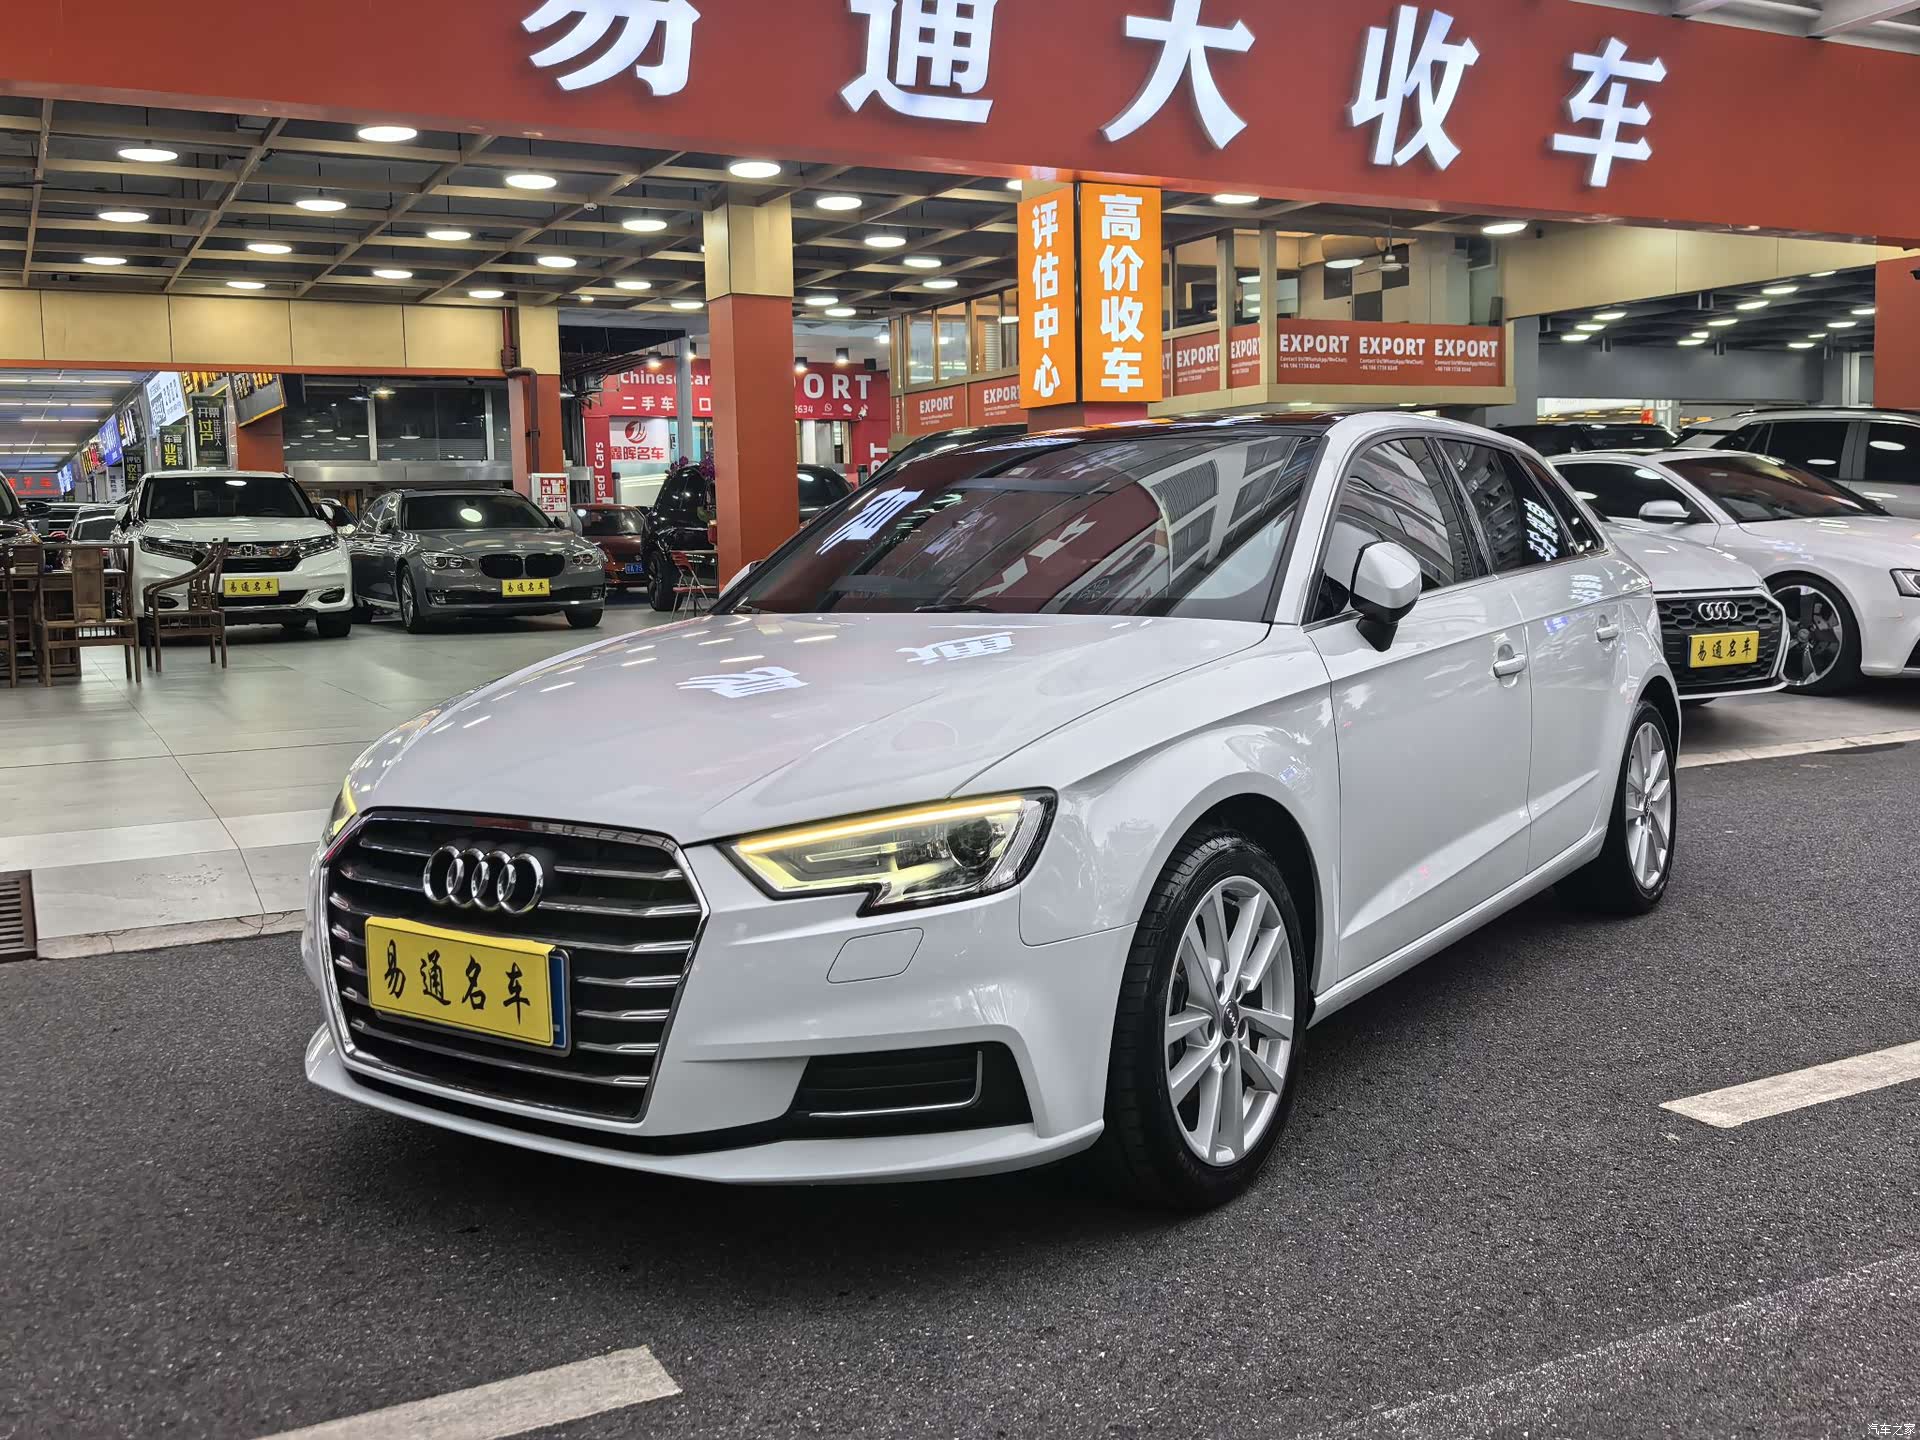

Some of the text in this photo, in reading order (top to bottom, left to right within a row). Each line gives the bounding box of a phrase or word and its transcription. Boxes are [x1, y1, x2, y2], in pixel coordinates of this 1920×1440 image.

[1032, 200, 1060, 398] 评估中心
[1099, 194, 1144, 393] 高价收车
[1280, 334, 1349, 353] EXPORT
[1360, 336, 1425, 356] EXPORT
[1435, 338, 1498, 358] EXPORT
[1176, 344, 1220, 368] EXPORT
[620, 370, 677, 385] Chines
[794, 373, 872, 400] ORT
[621, 396, 712, 411] 二手车口
[920, 396, 954, 414] EXPORT
[595, 442, 604, 468] Cars
[230, 581, 273, 592] 易通名车
[507, 581, 546, 592] 易通名车
[1698, 638, 1752, 661] 易通名车
[384, 939, 531, 1025] 易通名车
